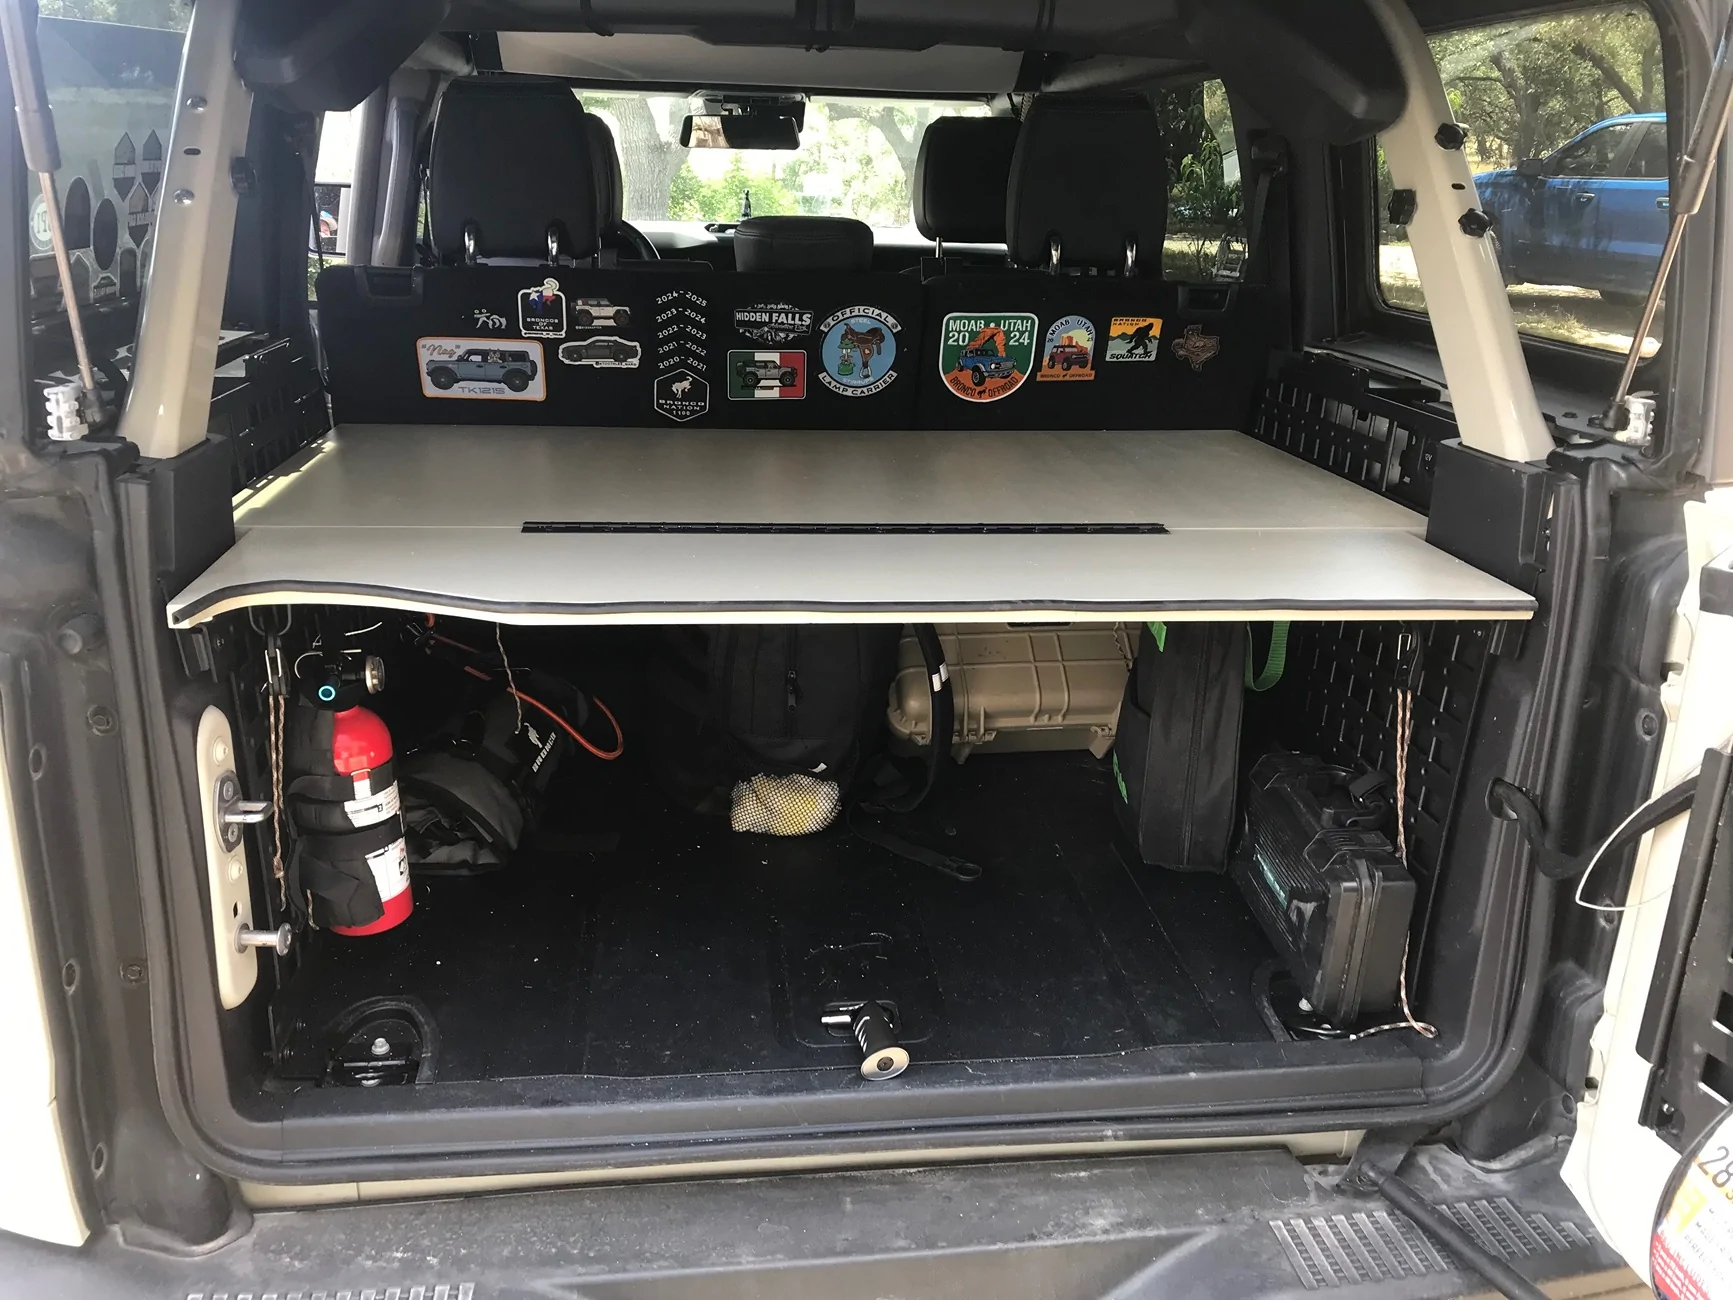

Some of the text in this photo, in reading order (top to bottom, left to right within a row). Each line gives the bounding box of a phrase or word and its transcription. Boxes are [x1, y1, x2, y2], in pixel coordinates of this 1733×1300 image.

[656, 290, 679, 304] 2024
[685, 291, 708, 307] 2025
[656, 308, 677, 323] 2023
[684, 308, 706, 324] 2024
[735, 312, 812, 326] HIDDEN FALLS
[831, 307, 890, 324] OFFICIAL
[657, 324, 679, 339] 2022
[685, 325, 707, 340] 2023
[949, 320, 1031, 331] MOAB UTAH
[1049, 319, 1094, 337] MOAB UTAH
[947, 332, 969, 346] 20
[1009, 331, 1030, 346] 24
[657, 341, 678, 354] 2021
[685, 341, 707, 357] 2022
[1109, 353, 1153, 361] SQUATCH
[657, 356, 680, 369] 2020
[687, 357, 707, 372] 2021
[821, 373, 895, 396] LAMP CARRIER
[949, 376, 1019, 398] BRONCO OFFROAD
[531, 731, 557, 773] BRONCO
